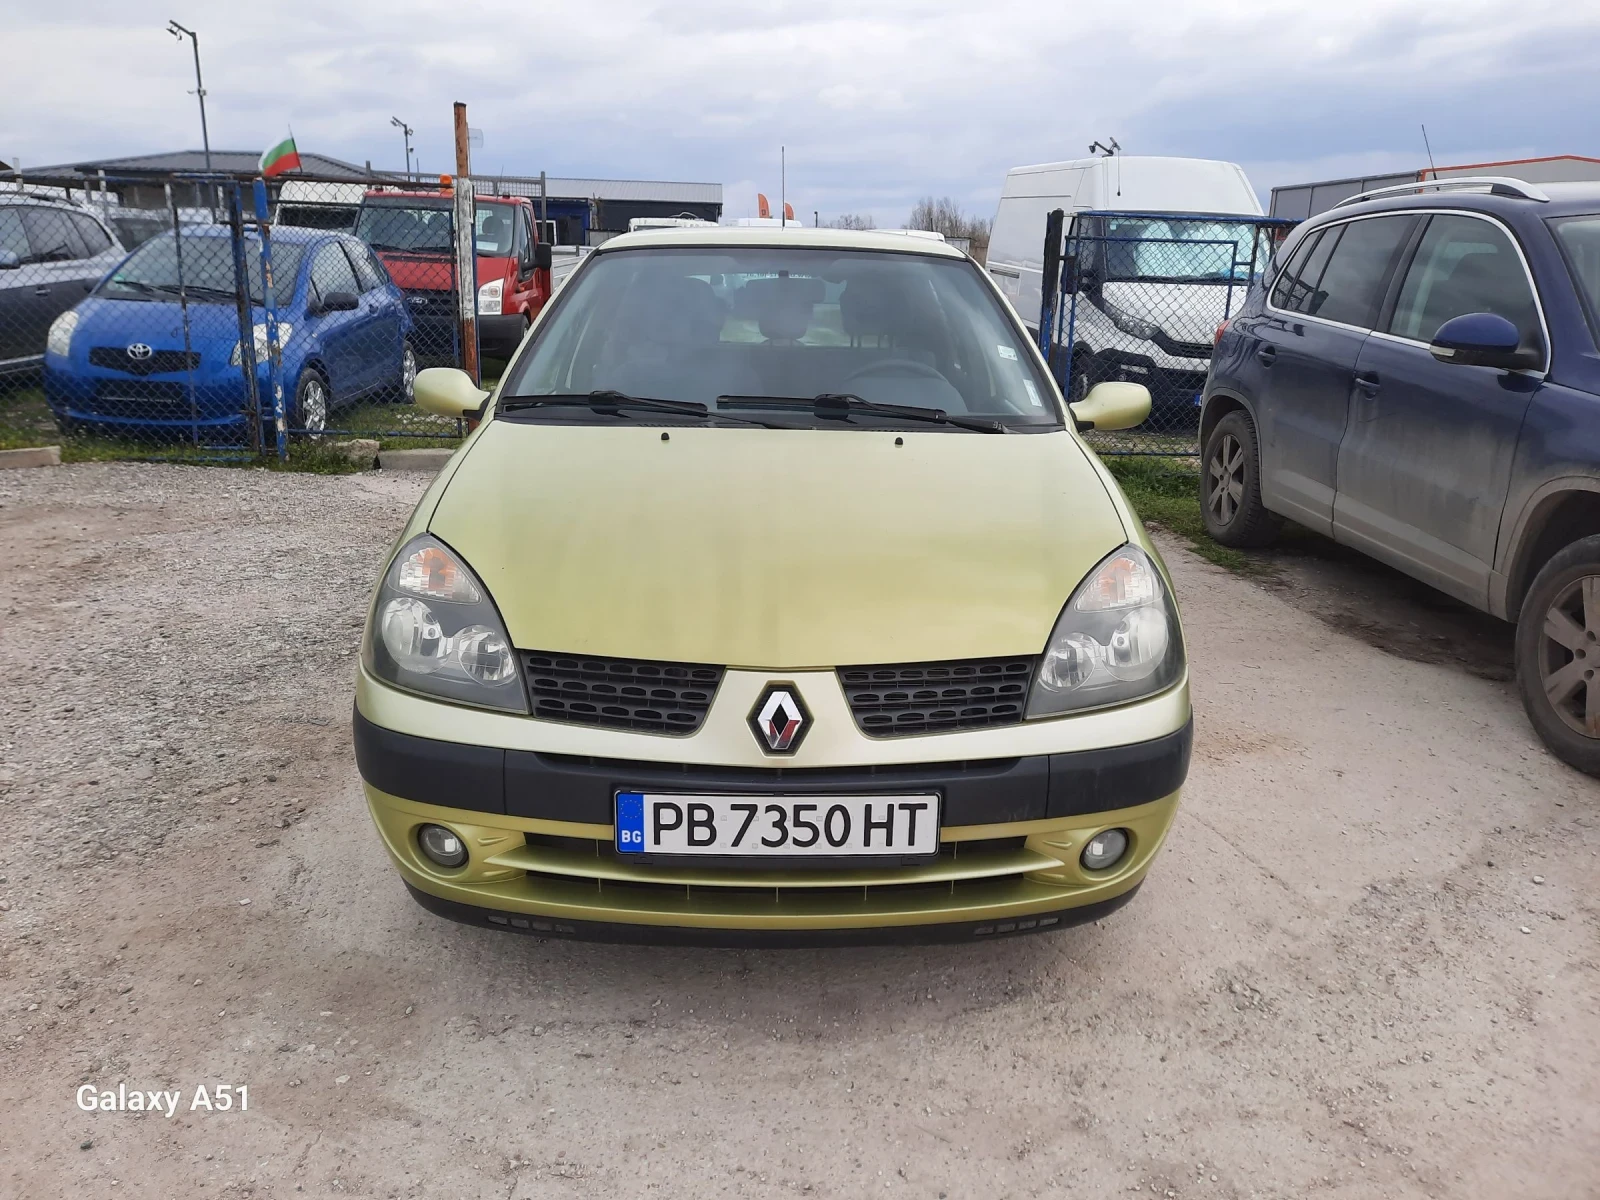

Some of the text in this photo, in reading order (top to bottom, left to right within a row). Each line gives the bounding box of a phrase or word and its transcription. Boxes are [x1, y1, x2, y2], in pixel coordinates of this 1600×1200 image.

[621, 829, 642, 843] BG
[652, 801, 928, 848] PB 7350 HT
